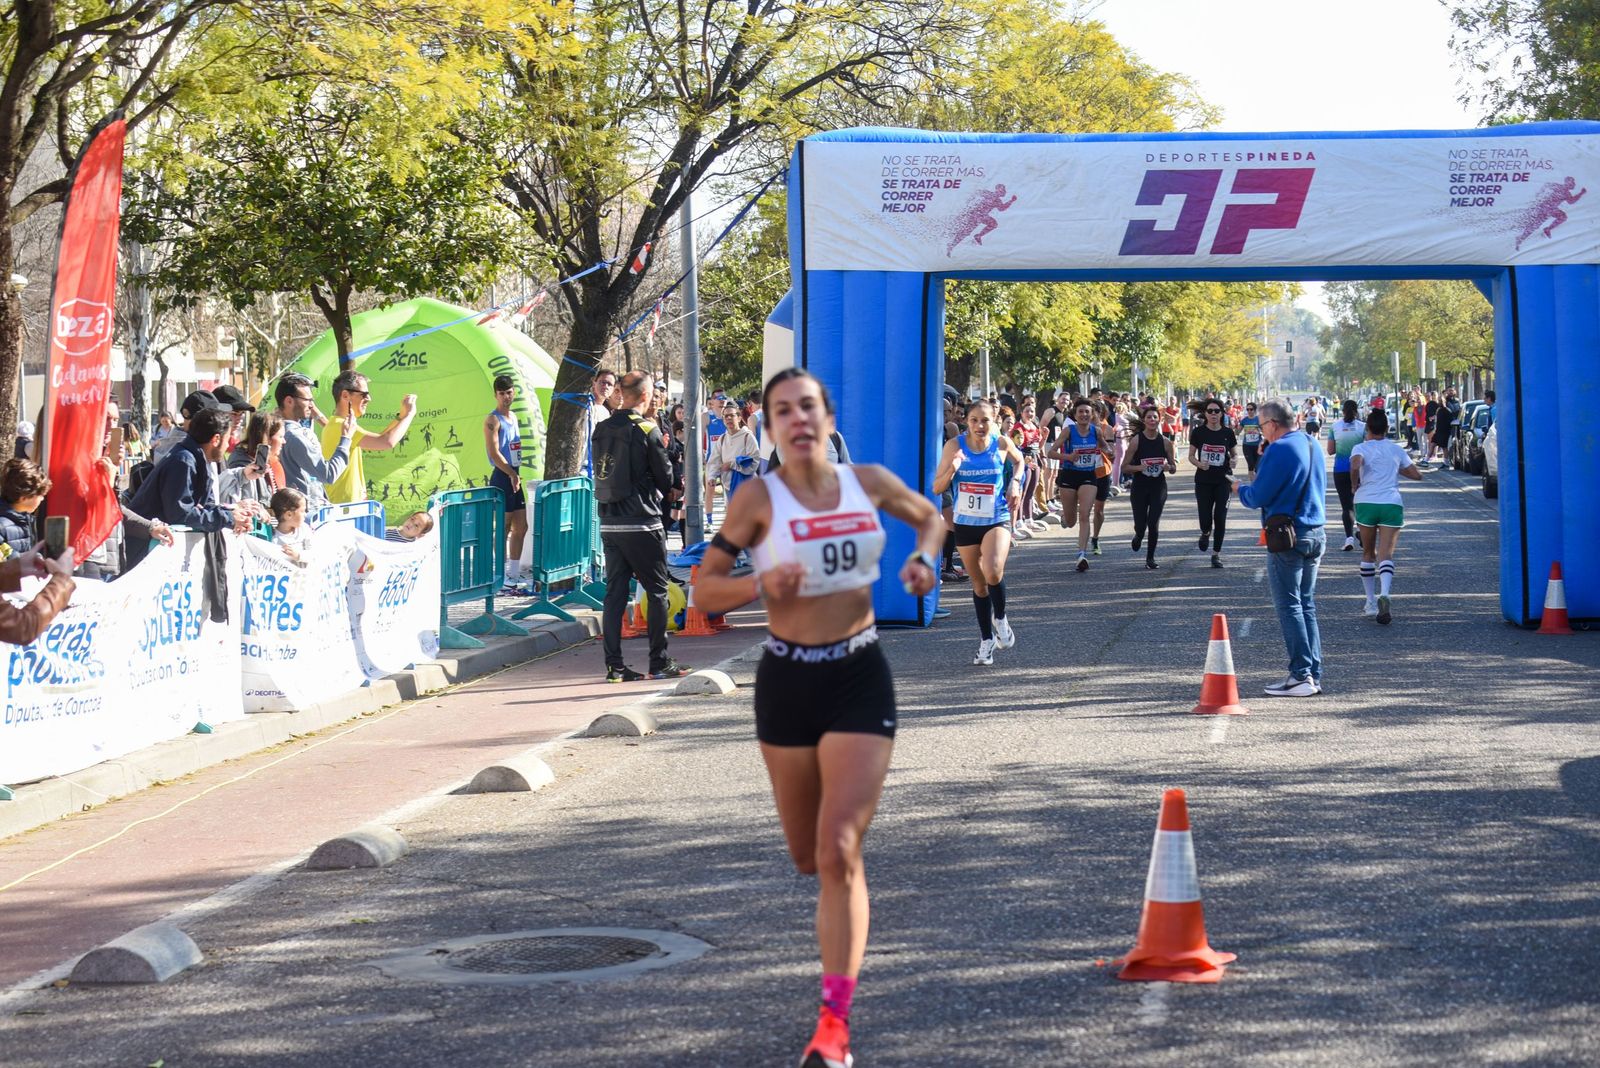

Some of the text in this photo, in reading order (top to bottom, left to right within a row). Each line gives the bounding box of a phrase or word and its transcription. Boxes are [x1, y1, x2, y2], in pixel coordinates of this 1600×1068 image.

[1448, 148, 1529, 159] NO SE TRATA
[881, 155, 961, 165] NO SE TRATA
[1448, 161, 1467, 171] DE
[1469, 160, 1521, 171] CORRER
[881, 167, 899, 177] DE
[902, 167, 954, 177] CORRER
[1450, 172, 1530, 183] SE TRATA DE
[881, 179, 962, 189] SE TRATA DE
[1449, 185, 1502, 195] CORRER
[881, 191, 934, 201] CORRER
[1450, 197, 1495, 207] MEJOR
[881, 203, 926, 213] MEJOR
[418, 407, 448, 418] origen
[1207, 453, 1220, 462] 184
[968, 495, 982, 510] 91
[823, 541, 857, 576] 99
[792, 641, 848, 662] NIKE
